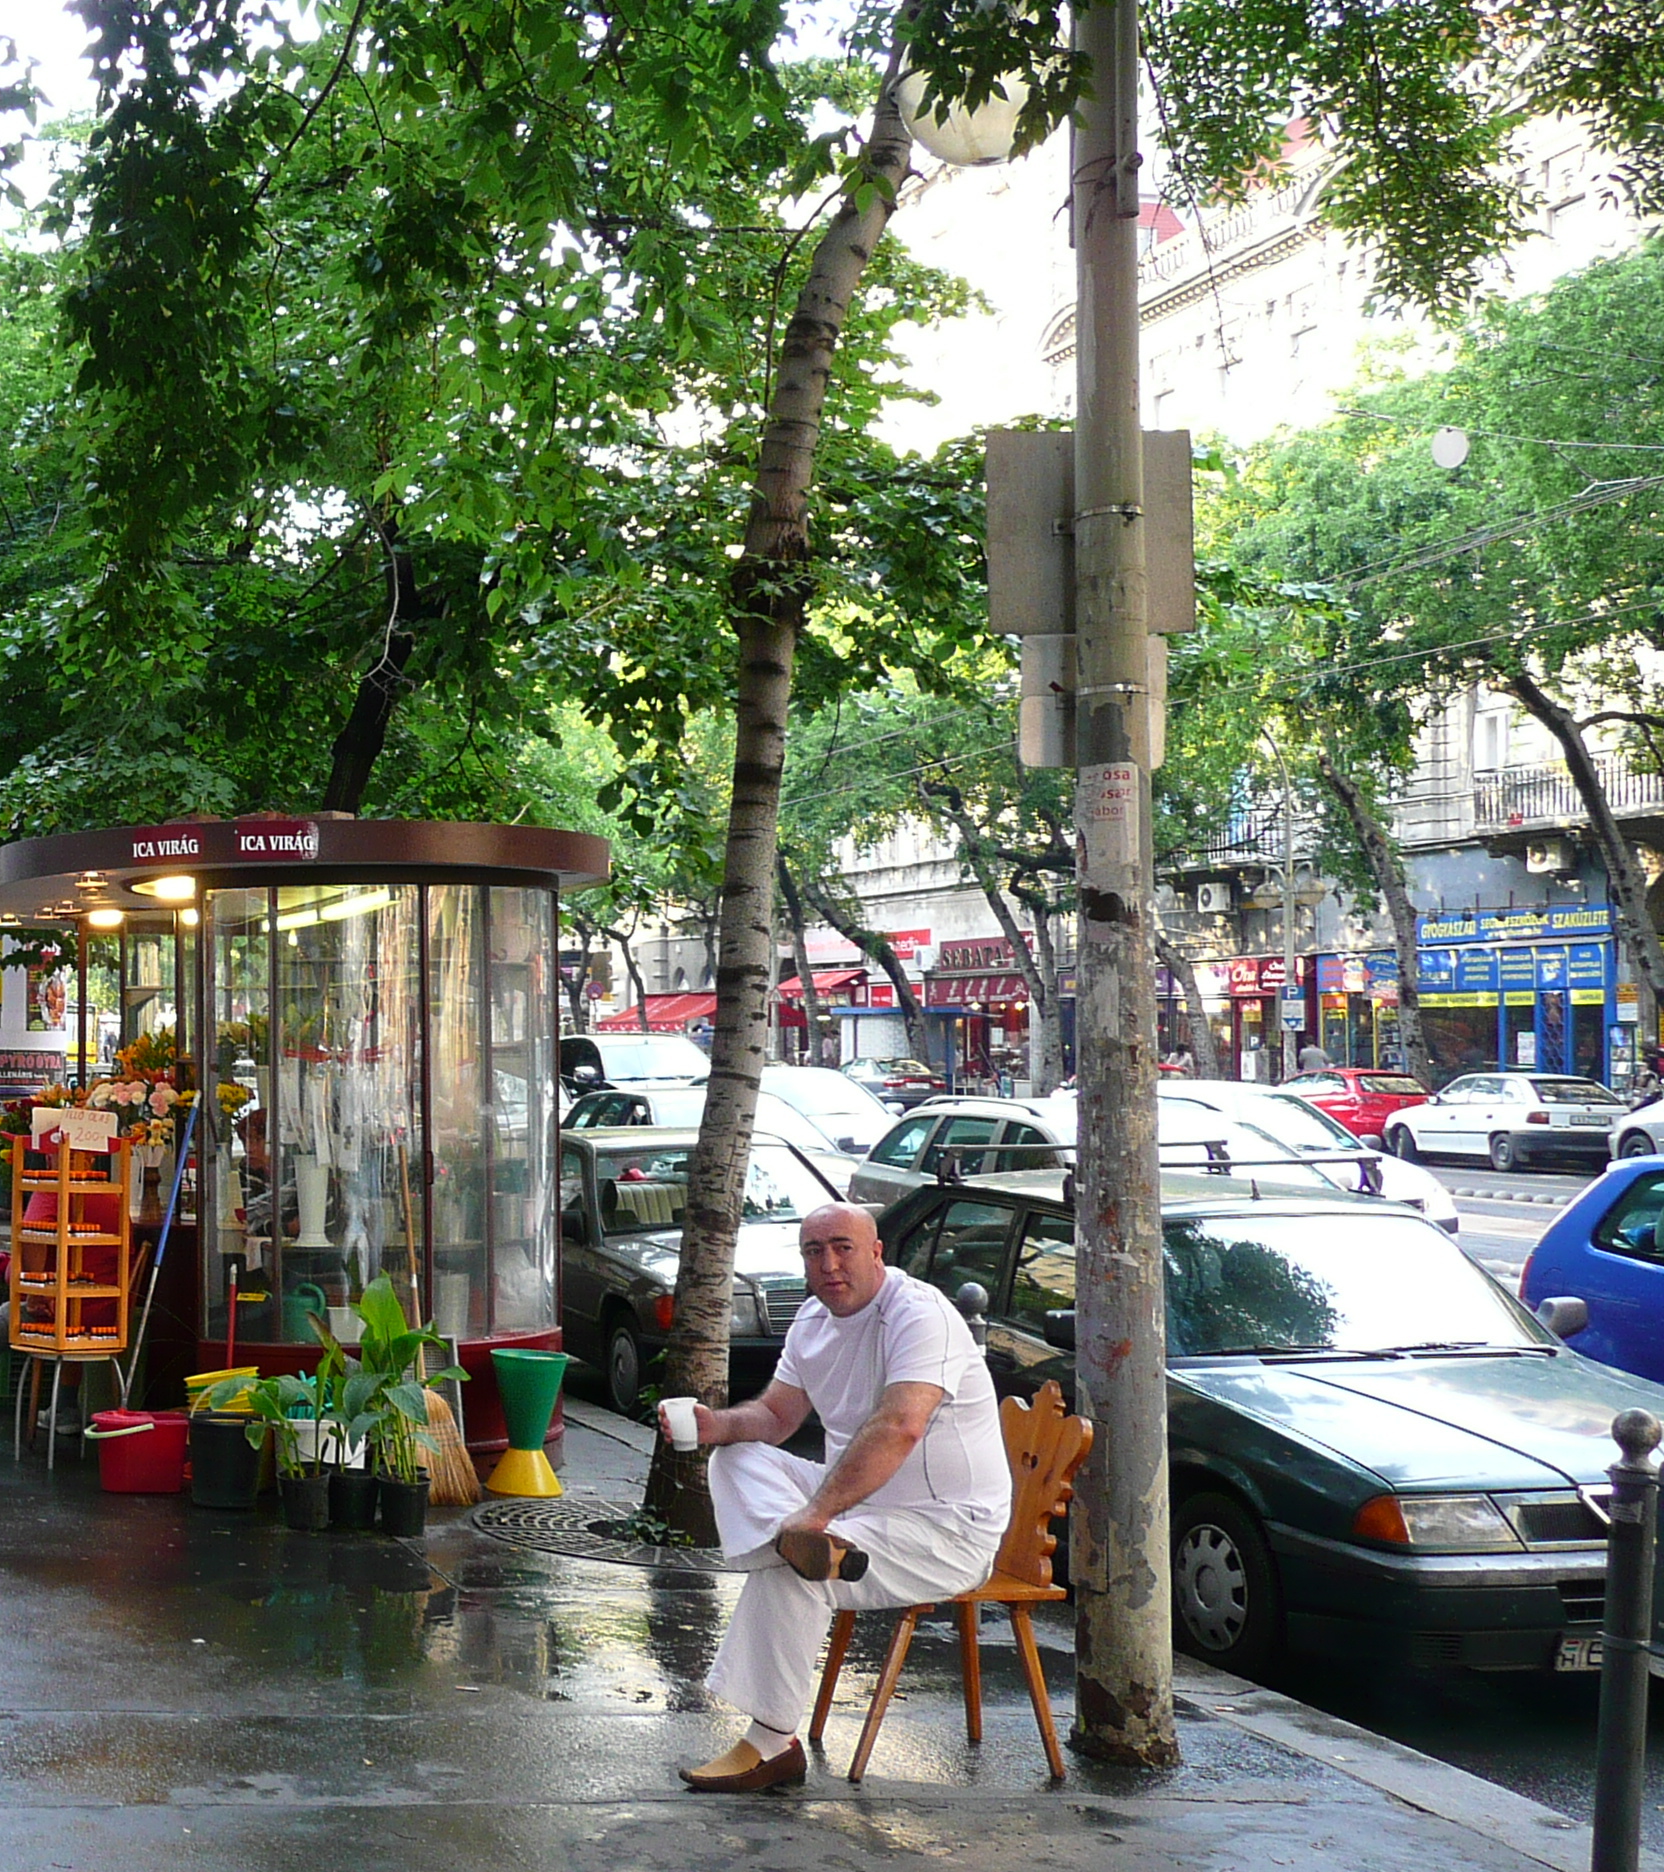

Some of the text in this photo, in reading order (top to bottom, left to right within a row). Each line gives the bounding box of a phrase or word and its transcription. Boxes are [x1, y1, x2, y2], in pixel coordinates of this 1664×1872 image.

[133, 833, 199, 858] ICA VIRÁG
[240, 829, 314, 851] ICA VIRÁG
[1552, 906, 1609, 929] SZAKÜZLETE
[1287, 986, 1298, 998] P
[1561, 1654, 1576, 1667] H
